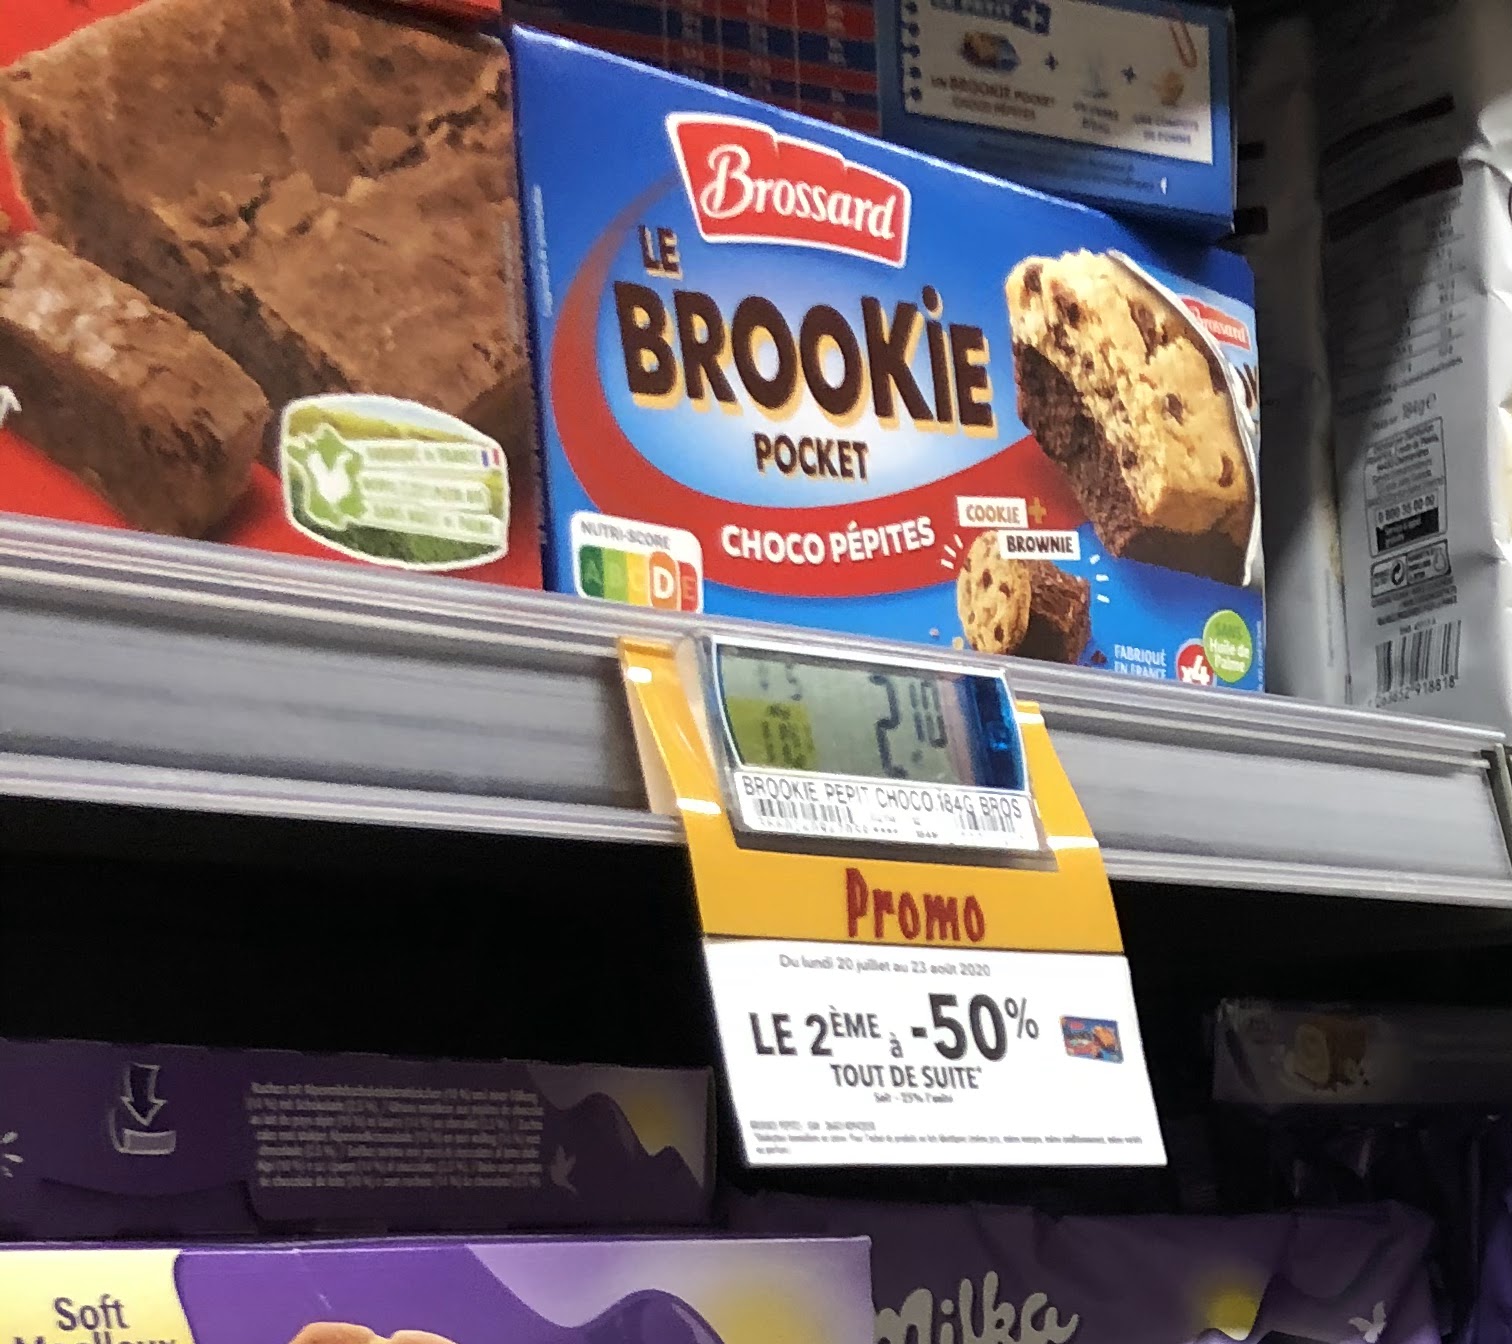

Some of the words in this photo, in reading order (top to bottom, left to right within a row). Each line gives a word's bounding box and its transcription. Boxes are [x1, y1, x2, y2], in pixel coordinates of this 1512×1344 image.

[703, 144, 896, 241] Brossard
[640, 224, 678, 275] LE
[753, 432, 869, 481] POCKET
[580, 520, 672, 550] NUTRI-SCORE
[965, 502, 1021, 527] COOKIE
[721, 523, 826, 565] CHOCO
[831, 515, 936, 563] PÉPITES
[1006, 534, 1074, 556] BROWNIE
[1114, 643, 1167, 667] FABRIQUÉ
[742, 774, 819, 802] BROOKIE
[875, 787, 933, 812] CHOCO
[979, 797, 1022, 818] BROS
[844, 868, 986, 943] Promo
[779, 954, 800, 969] Du
[802, 954, 833, 970] lundi
[837, 957, 854, 970] 20
[856, 957, 891, 975] juillet
[959, 962, 991, 977] 2020
[749, 1011, 797, 1057] LE
[805, 1004, 882, 1057] 2ÈME
[889, 1030, 904, 1058] à
[911, 992, 1040, 1062] -50%
[830, 1063, 885, 1088] TOUT
[891, 1064, 918, 1088] DE
[53, 1292, 131, 1332] Soft
